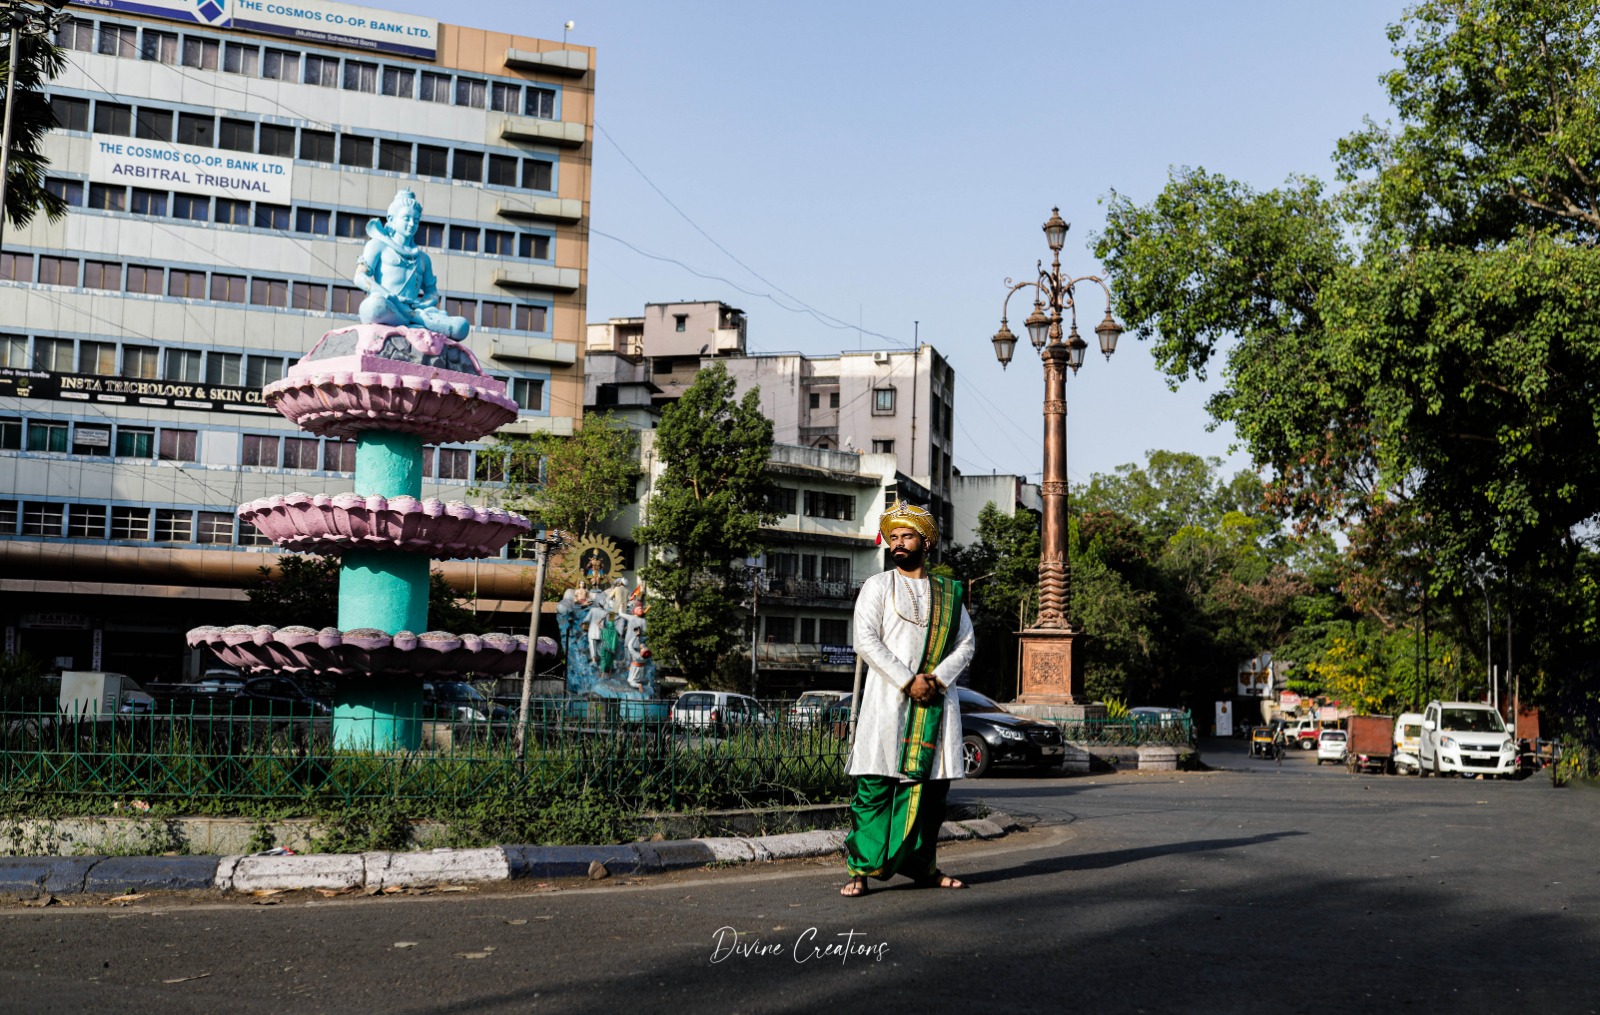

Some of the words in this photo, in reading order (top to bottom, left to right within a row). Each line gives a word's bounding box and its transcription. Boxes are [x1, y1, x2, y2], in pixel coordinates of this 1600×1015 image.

[239, 1, 263, 11] THE
[267, 4, 322, 21] COSMOS
[326, 13, 366, 28] CO-OP.
[370, 21, 403, 33] BANK
[407, 27, 431, 38] LTD.
[99, 142, 123, 154] THE
[127, 146, 180, 162] COSMOS
[183, 154, 223, 167] CO-OP.
[227, 159, 259, 171] BANK
[262, 164, 286, 175] LTD.
[112, 163, 191, 183] ARBITRAL
[195, 173, 271, 193] TRIBUNAL
[61, 376, 102, 390] INSTA
[105, 380, 191, 398] TRICHOLOGY
[195, 387, 206, 399] &
[210, 389, 242, 402] SKIN
